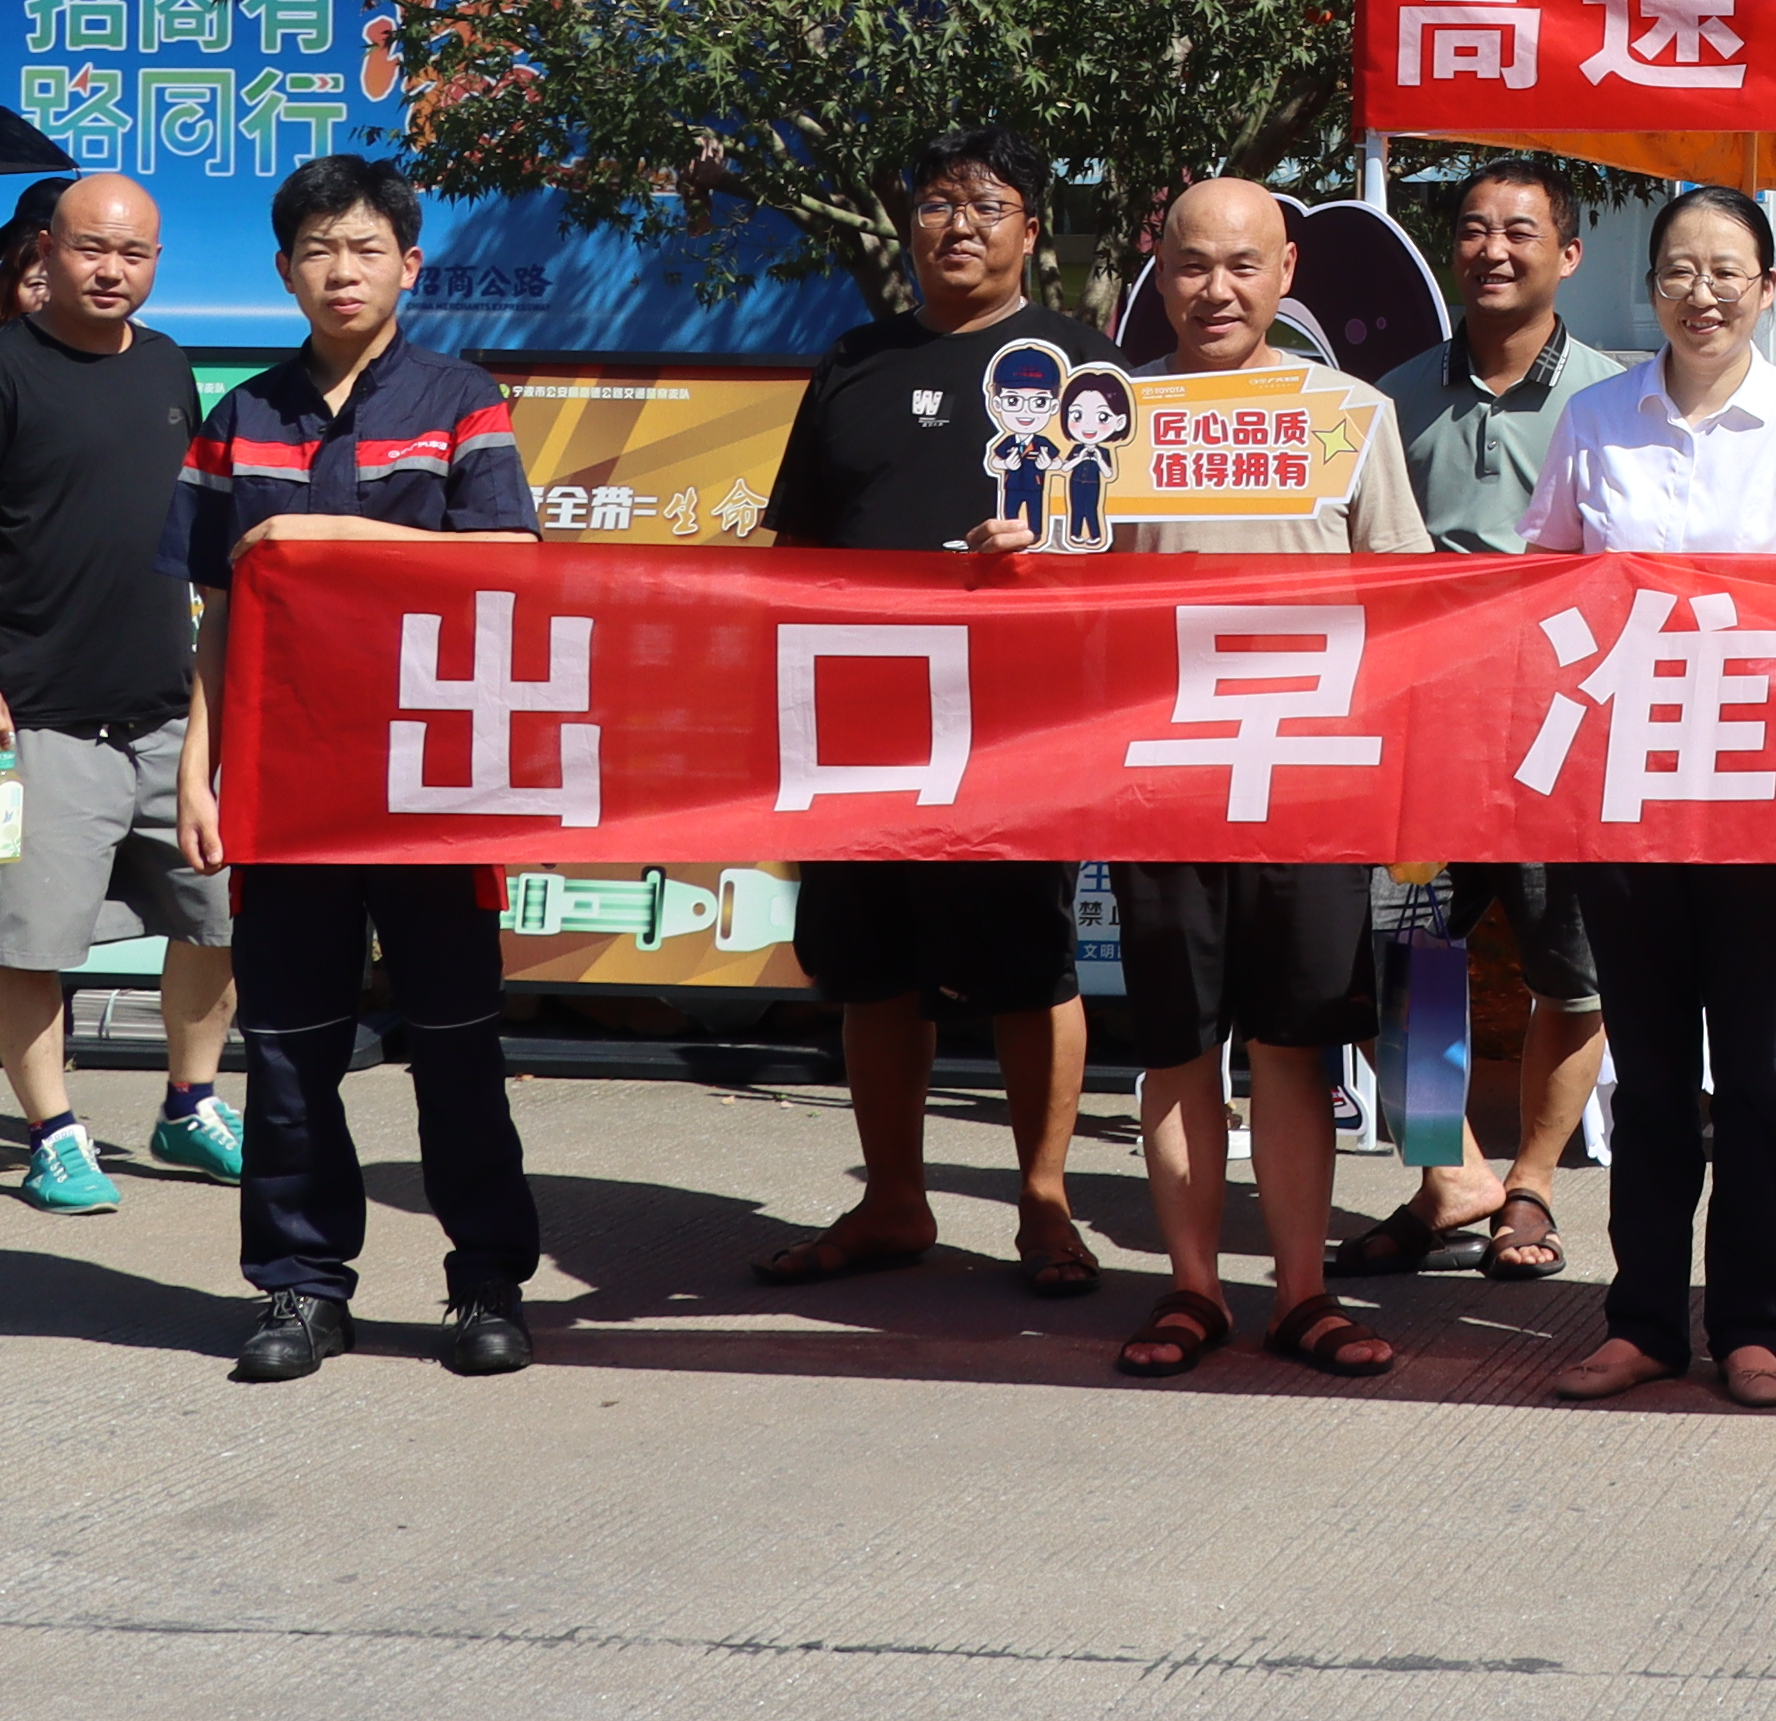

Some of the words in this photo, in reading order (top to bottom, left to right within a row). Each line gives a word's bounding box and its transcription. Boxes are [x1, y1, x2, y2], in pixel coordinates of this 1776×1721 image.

[1152, 410, 1310, 447] 匠心品质
[1152, 451, 1310, 489] 值得拥有
